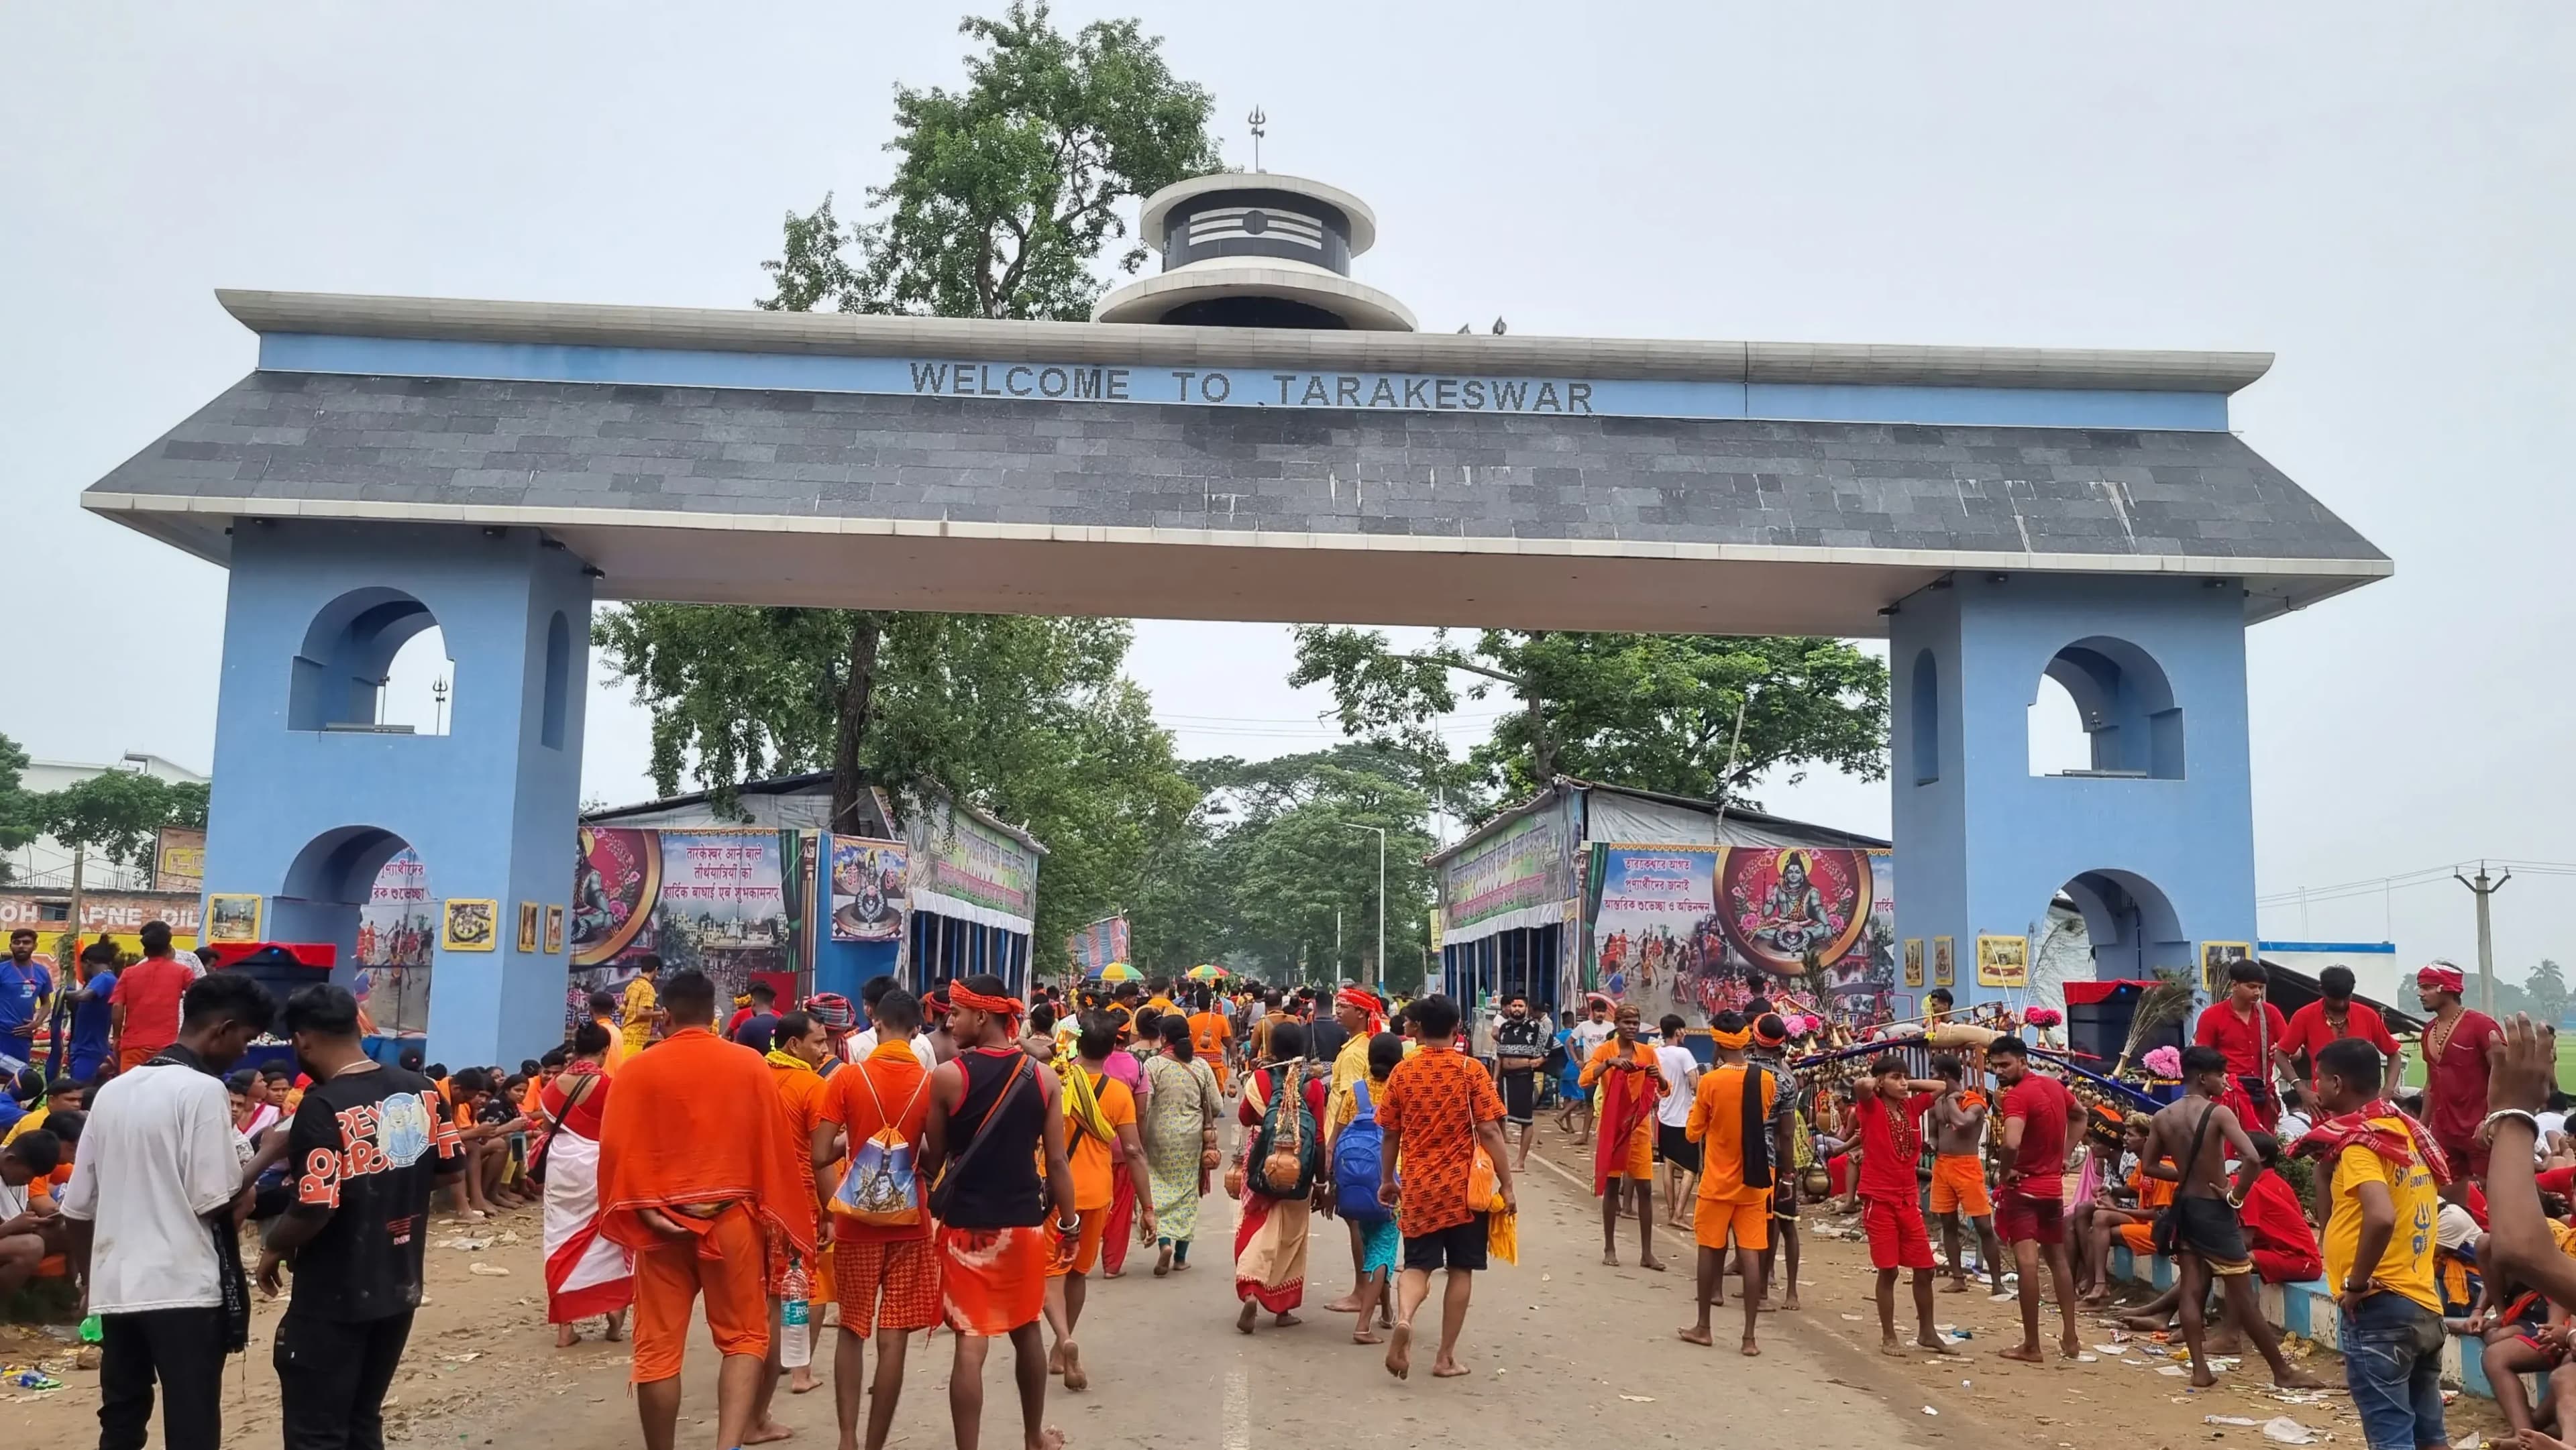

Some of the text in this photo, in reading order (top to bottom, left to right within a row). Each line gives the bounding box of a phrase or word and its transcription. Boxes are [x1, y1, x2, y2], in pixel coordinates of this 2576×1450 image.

[910, 363, 1593, 413] WELCOME TO TARAKESWAR
[726, 844, 742, 860] आने
[740, 863, 752, 879] को
[663, 882, 689, 899] हार्दिक
